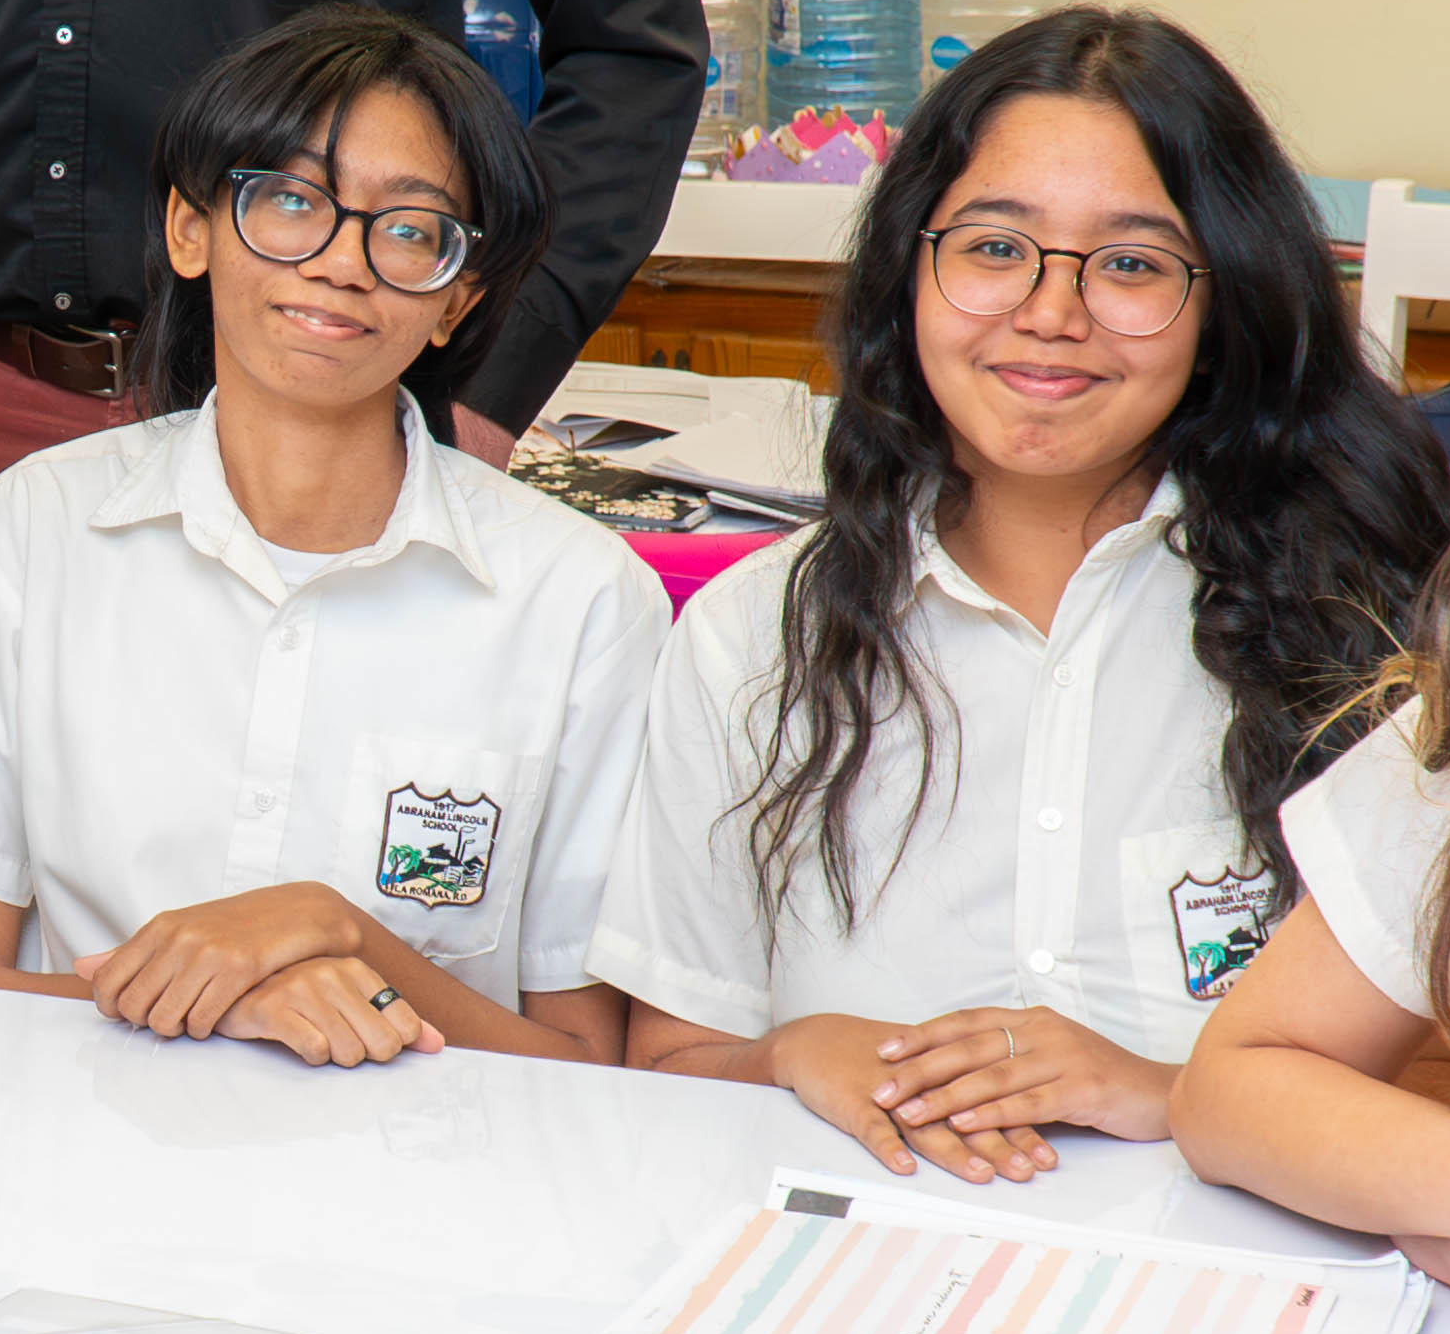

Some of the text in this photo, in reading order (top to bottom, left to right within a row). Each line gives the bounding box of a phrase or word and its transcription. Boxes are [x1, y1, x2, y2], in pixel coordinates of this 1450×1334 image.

[433, 802, 457, 812] 1917
[397, 805, 488, 826] ABRAHAM LINCOLN
[421, 820, 458, 832] SCHOOL
[1186, 894, 1234, 911] ABRAHAM
